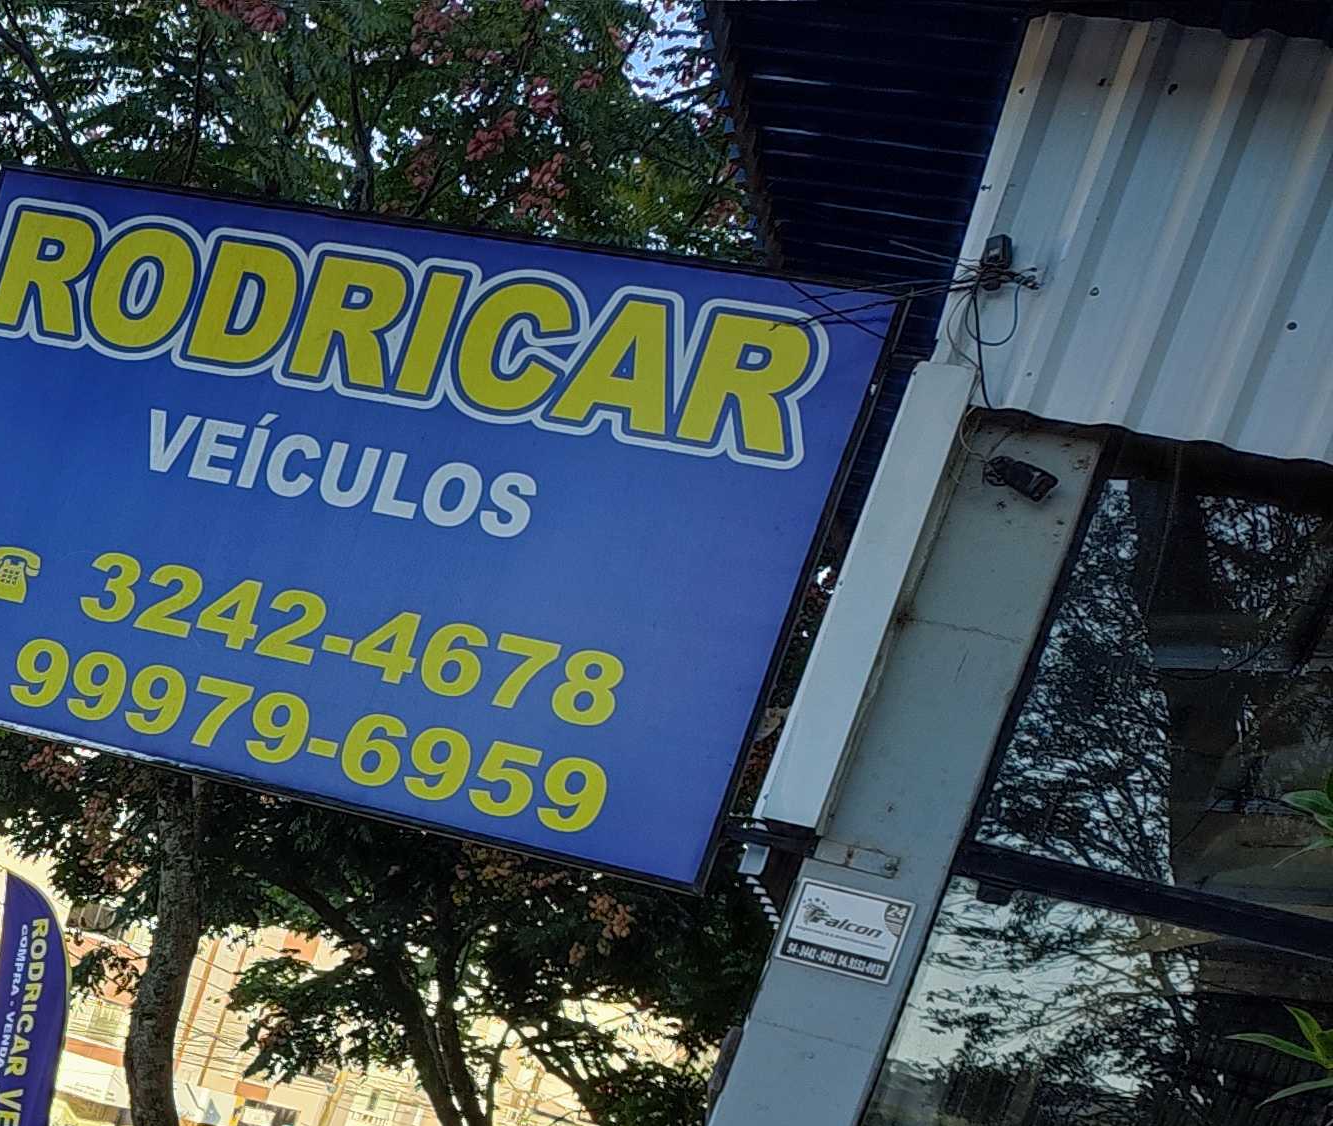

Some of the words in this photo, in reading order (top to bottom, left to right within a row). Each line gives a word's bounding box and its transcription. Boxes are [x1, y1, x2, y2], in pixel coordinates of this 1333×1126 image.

[147, 408, 537, 538] VEÍCULOS
[79, 550, 625, 727] 3242-4678
[11, 636, 608, 832] 99979-6959
[10, 924, 28, 996] COMPRA
[810, 910, 883, 939] Falcon
[886, 903, 908, 919] 24
[4, 918, 49, 1076] RODRICAR
